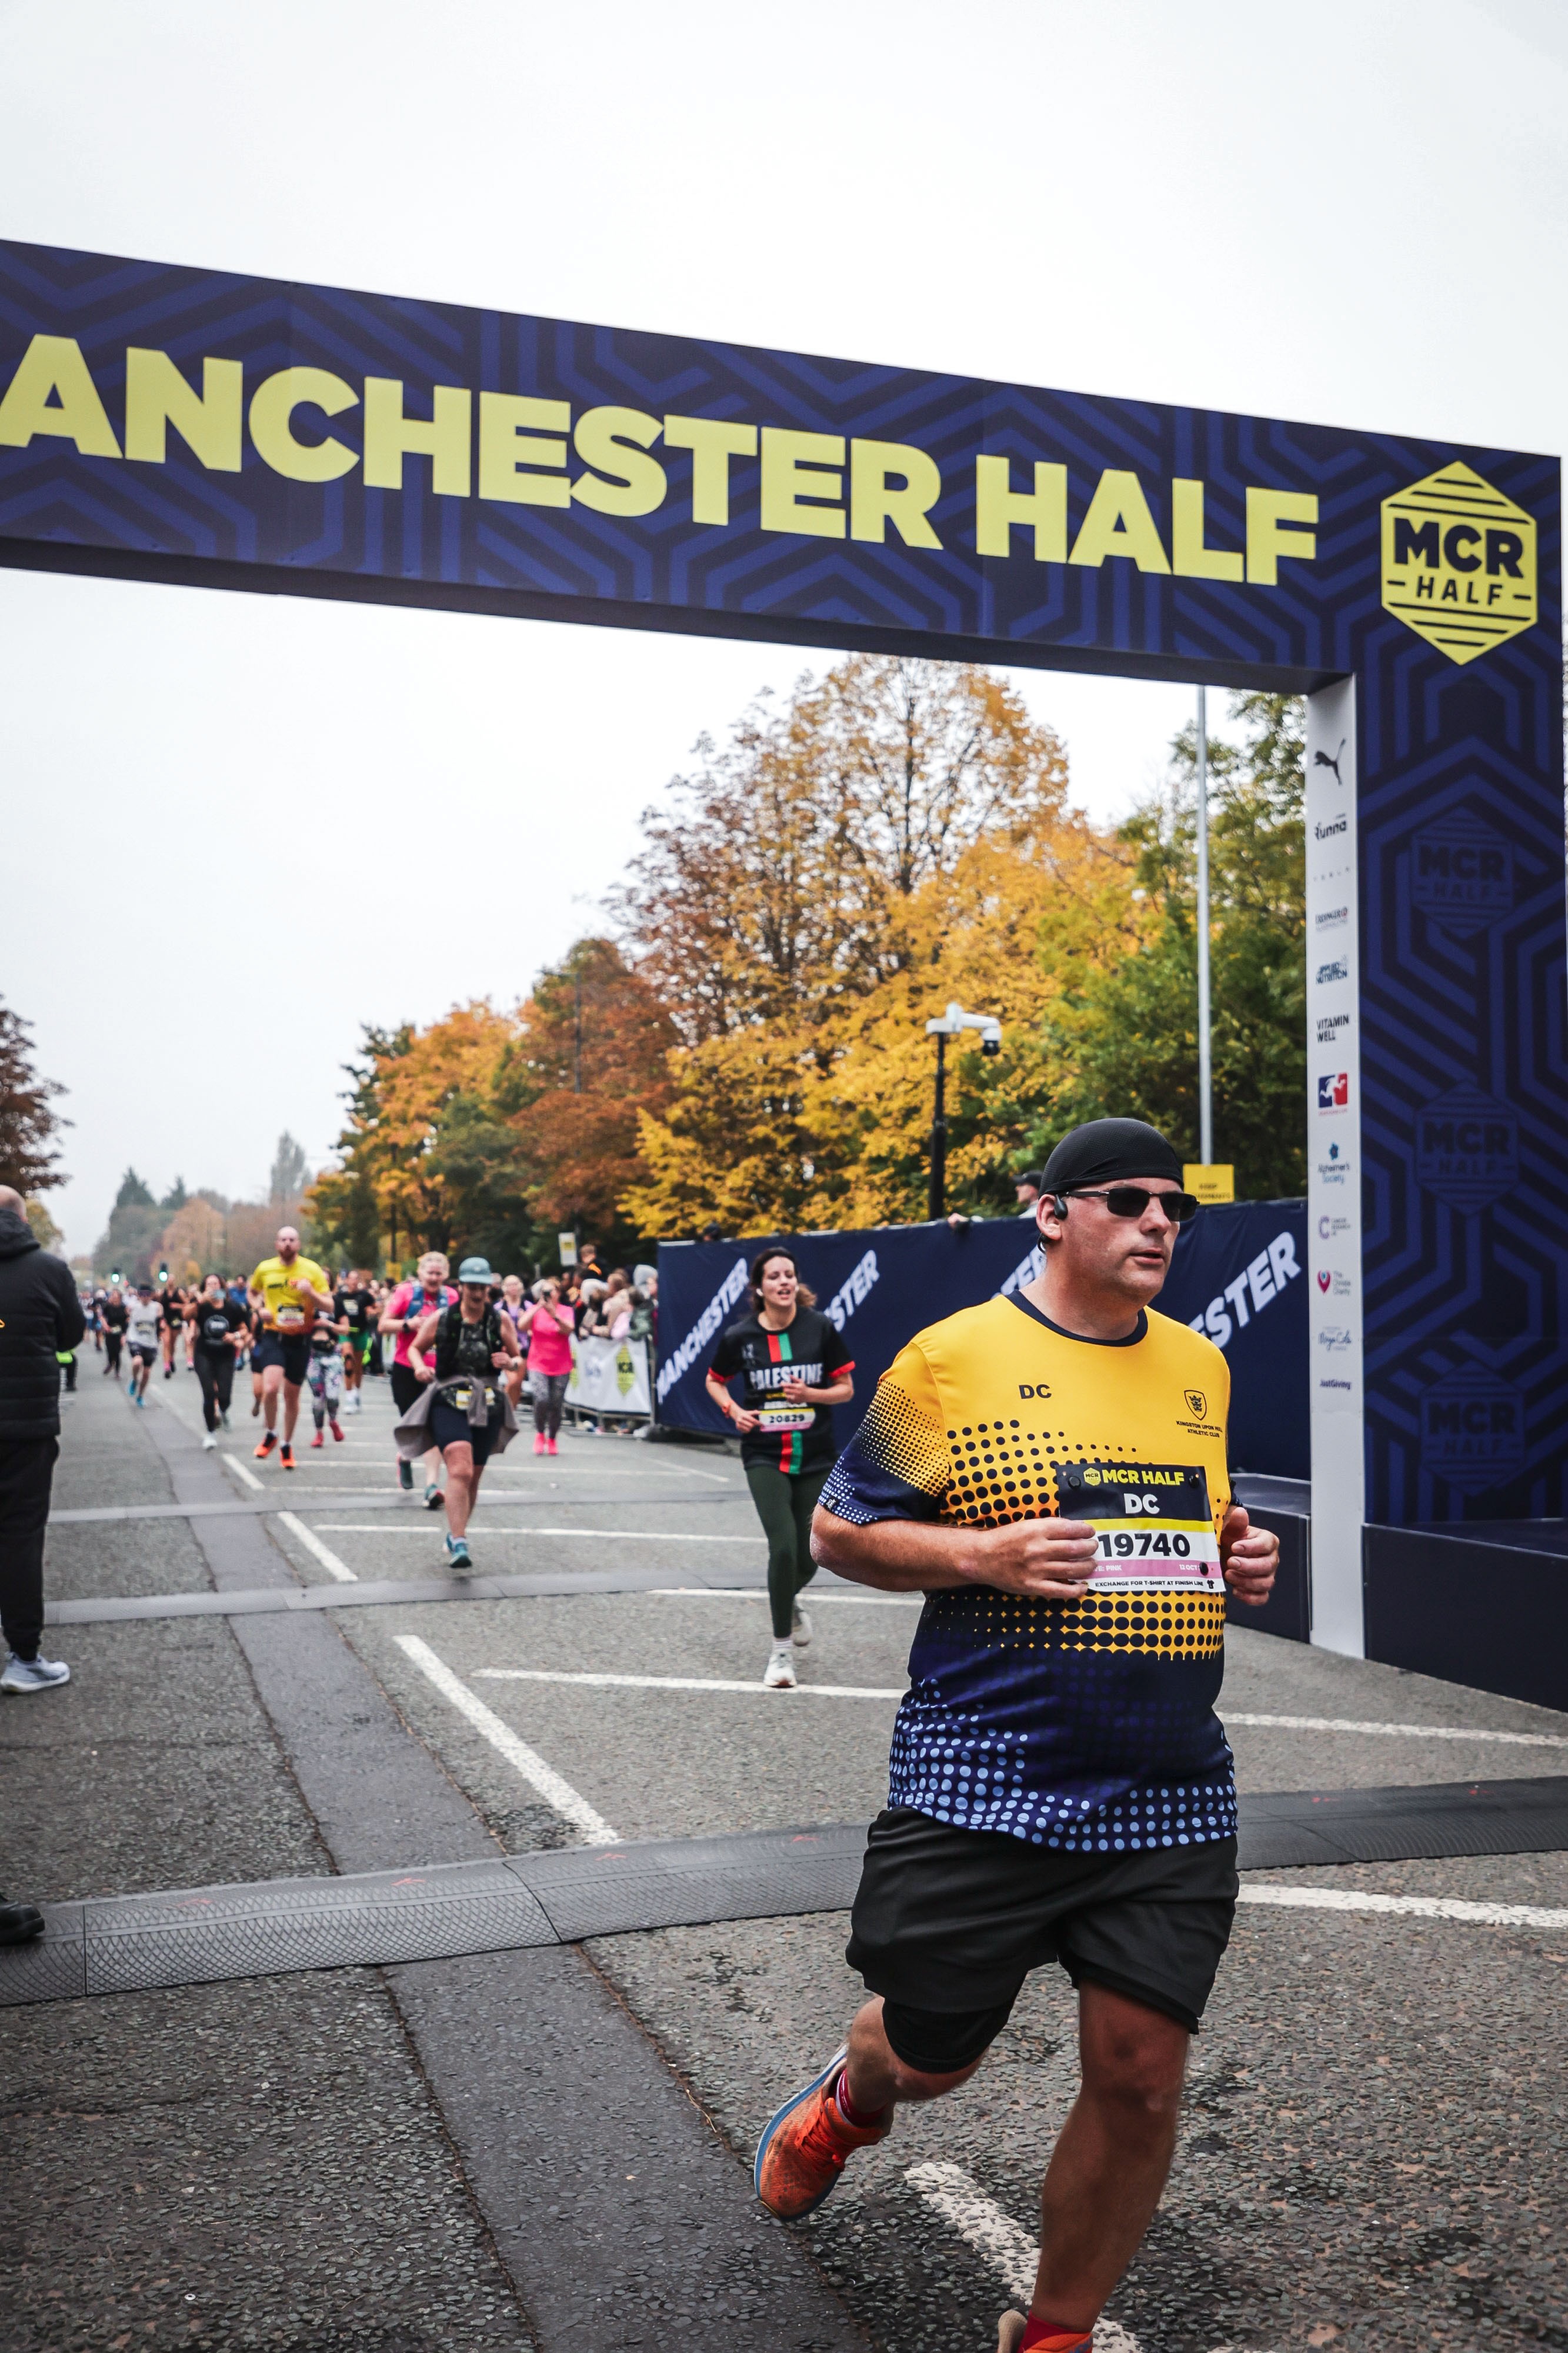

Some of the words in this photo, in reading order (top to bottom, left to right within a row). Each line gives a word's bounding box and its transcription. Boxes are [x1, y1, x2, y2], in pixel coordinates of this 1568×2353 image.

[976, 454, 1319, 586] HALF
[1393, 517, 1524, 579] MCR
[1416, 575, 1503, 606] HALF
[1418, 844, 1504, 881] MCR
[1316, 969, 1347, 984] NUTRITION
[1316, 1014, 1349, 1030] VITAMIN
[1317, 1031, 1336, 1043] WELL
[1423, 1121, 1510, 1155] MCR
[823, 1249, 880, 1333] STER
[1019, 1384, 1052, 1399] DC
[769, 1414, 805, 1424] 20829
[1176, 1421, 1201, 1429] KINGSTON
[1428, 1401, 1516, 1435] MCR
[1102, 1469, 1140, 1484] MCR
[1142, 1470, 1185, 1486] HALF
[1123, 1493, 1160, 1515] DC
[1097, 1533, 1190, 1558] 19740
